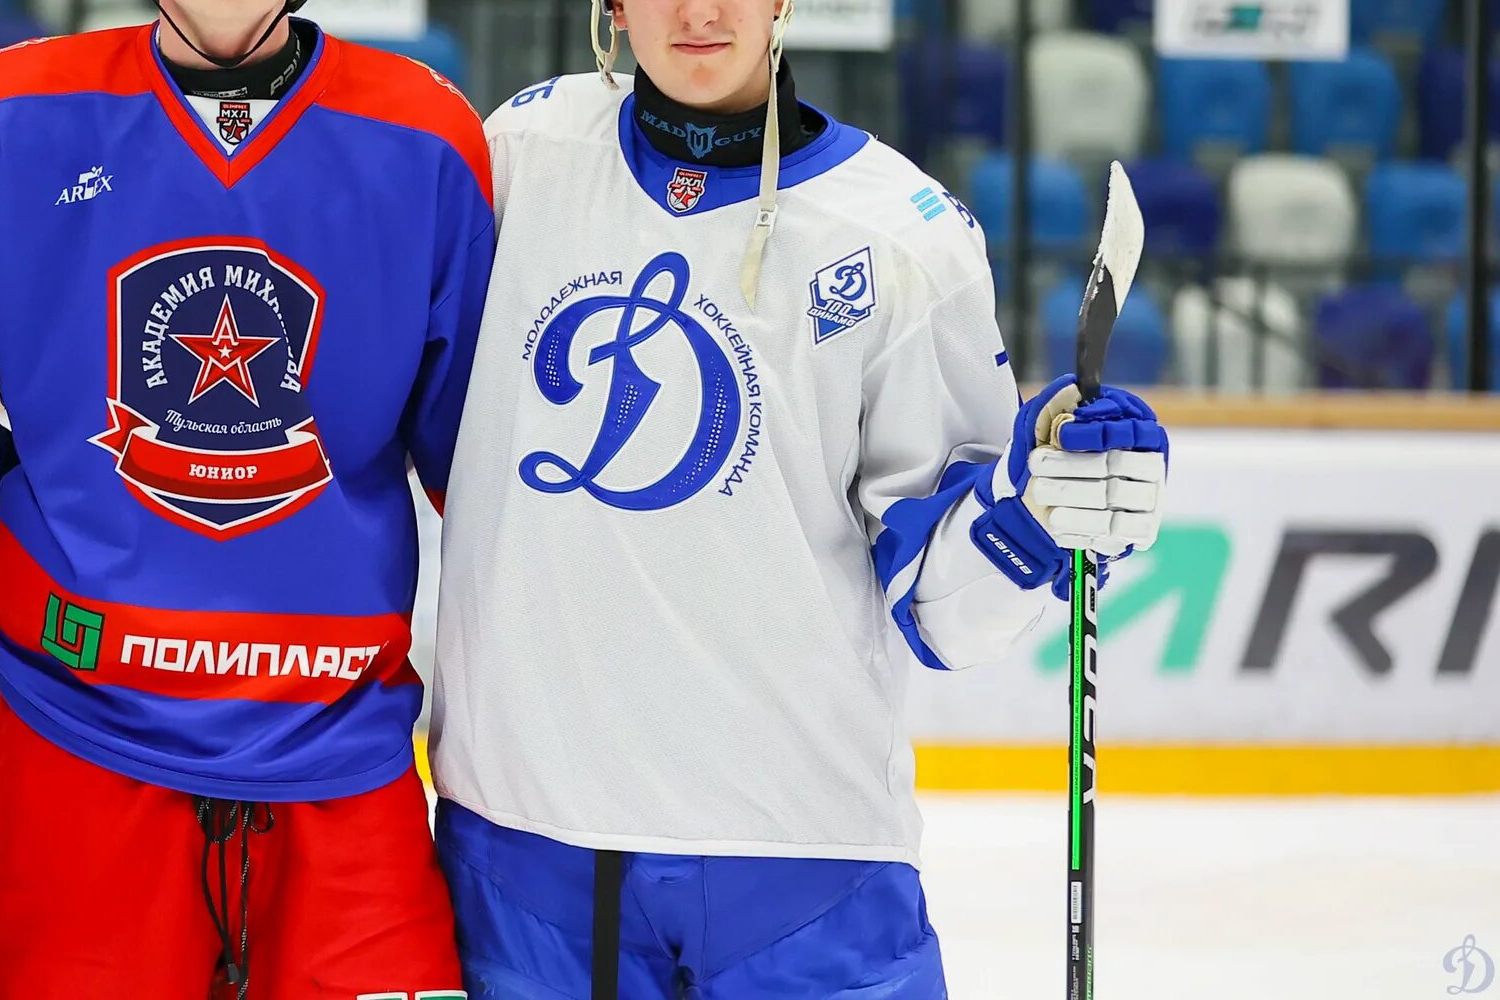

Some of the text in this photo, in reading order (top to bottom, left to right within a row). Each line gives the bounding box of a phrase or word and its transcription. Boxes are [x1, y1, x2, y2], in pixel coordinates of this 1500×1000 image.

[222, 109, 248, 119] МХЛ
[640, 110, 763, 147] MAD GUY
[675, 175, 702, 187] МХЛ
[808, 307, 856, 327] ДИНАМО
[824, 299, 853, 317] 100
[142, 266, 216, 390] АКАДЕМИЯ
[522, 271, 762, 497] МОЛОДЕЖНАЯ ХОККЕЙНАЯ КОМАНДА
[165, 409, 283, 434] Тульская область
[189, 463, 258, 480] ЮНИОР
[986, 533, 1033, 575] BAUER
[120, 634, 390, 681] ПОЛИПЛАСТ
